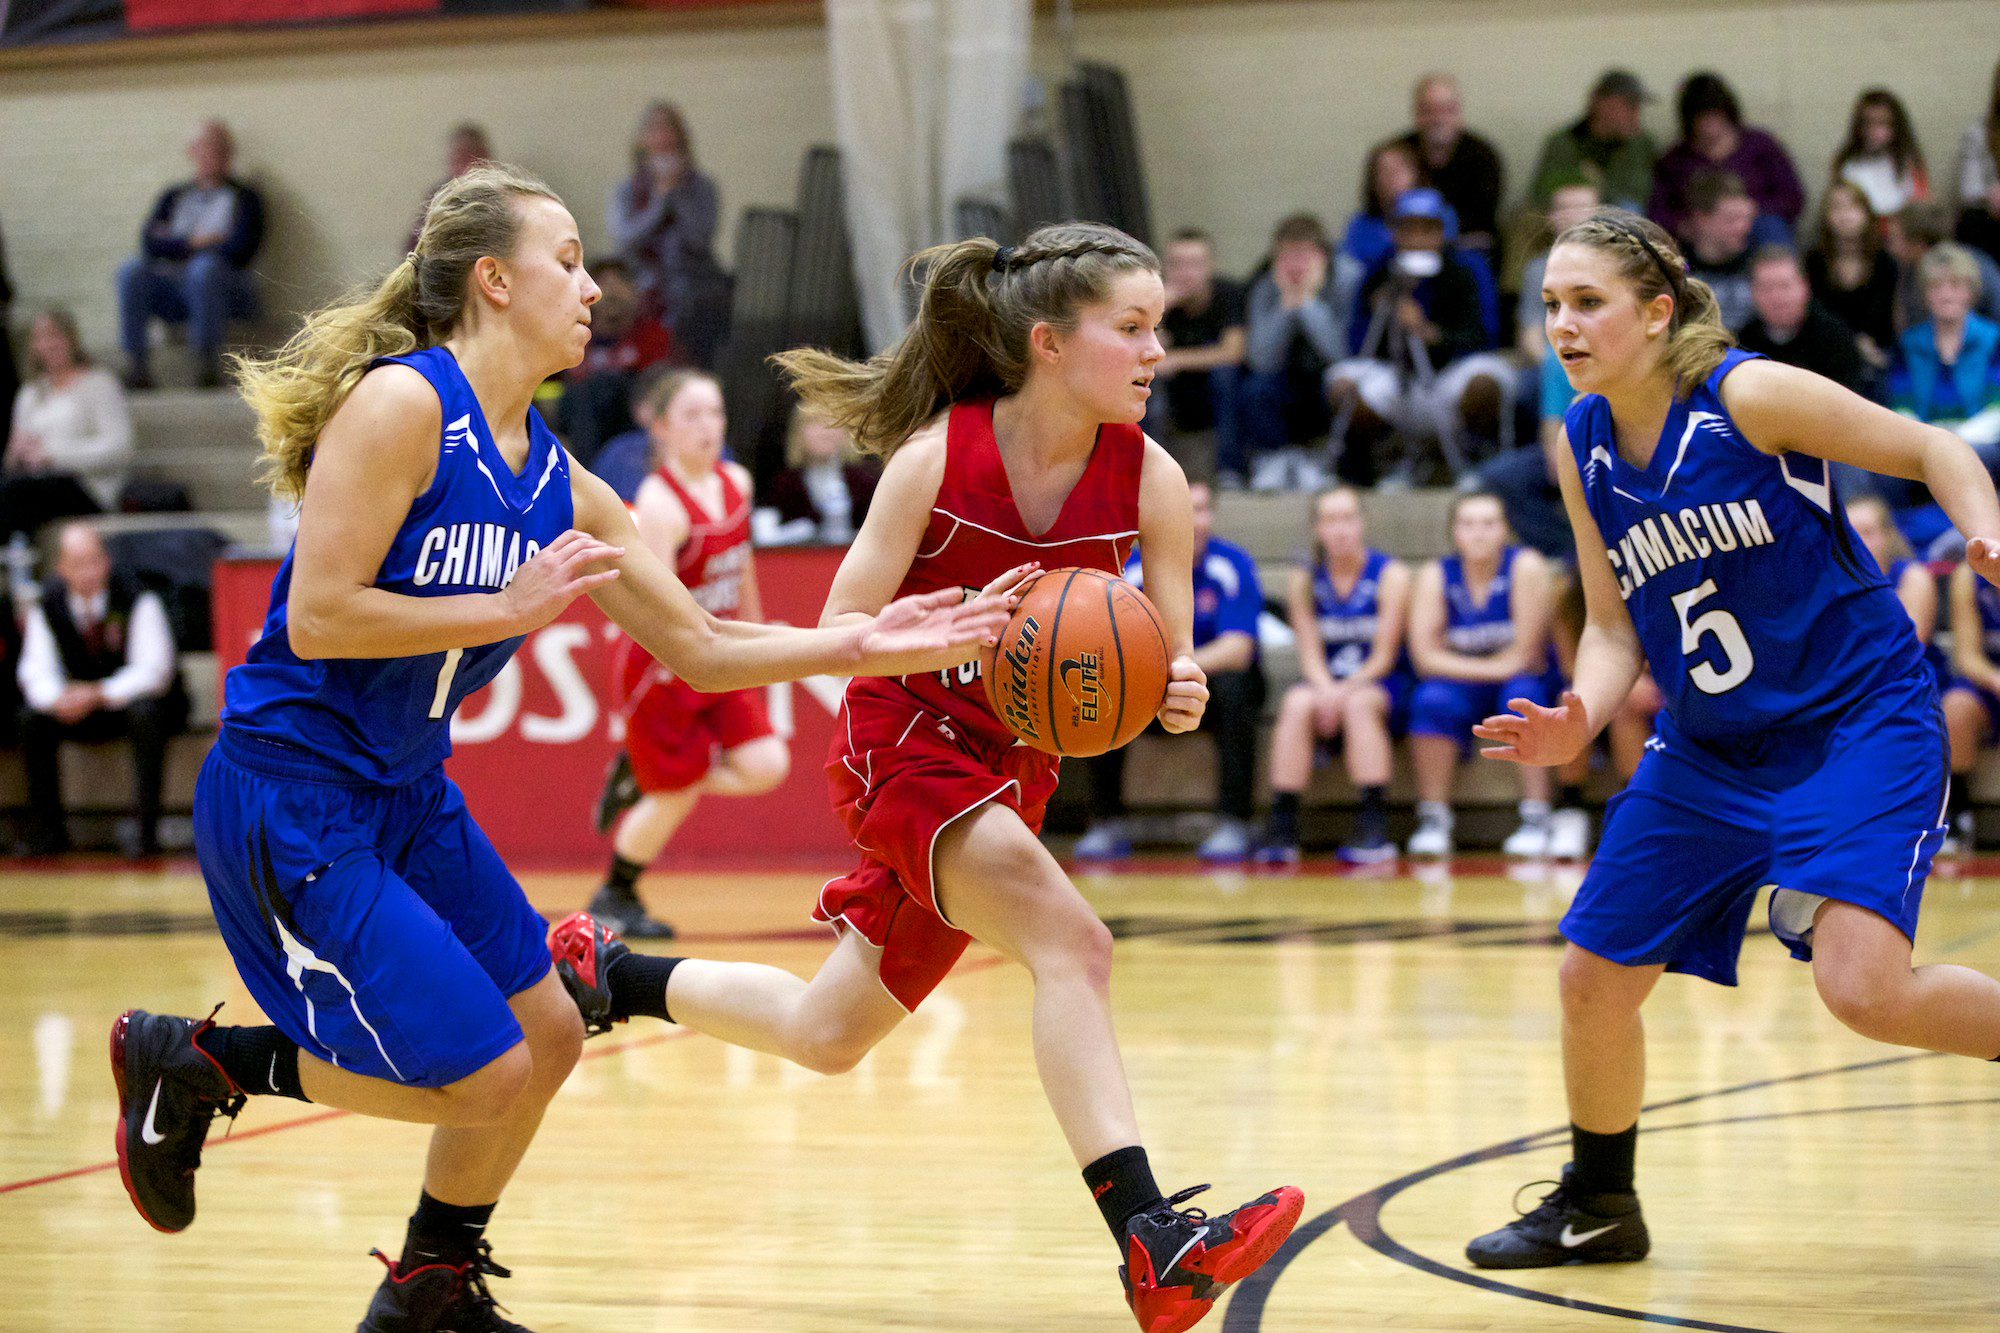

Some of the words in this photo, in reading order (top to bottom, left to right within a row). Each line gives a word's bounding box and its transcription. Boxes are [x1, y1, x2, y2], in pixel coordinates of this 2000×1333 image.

[1606, 499, 1775, 600] CHMACUM
[1671, 578, 1754, 694] 5
[428, 648, 464, 719] 1
[1080, 652, 1098, 723] ELITE
